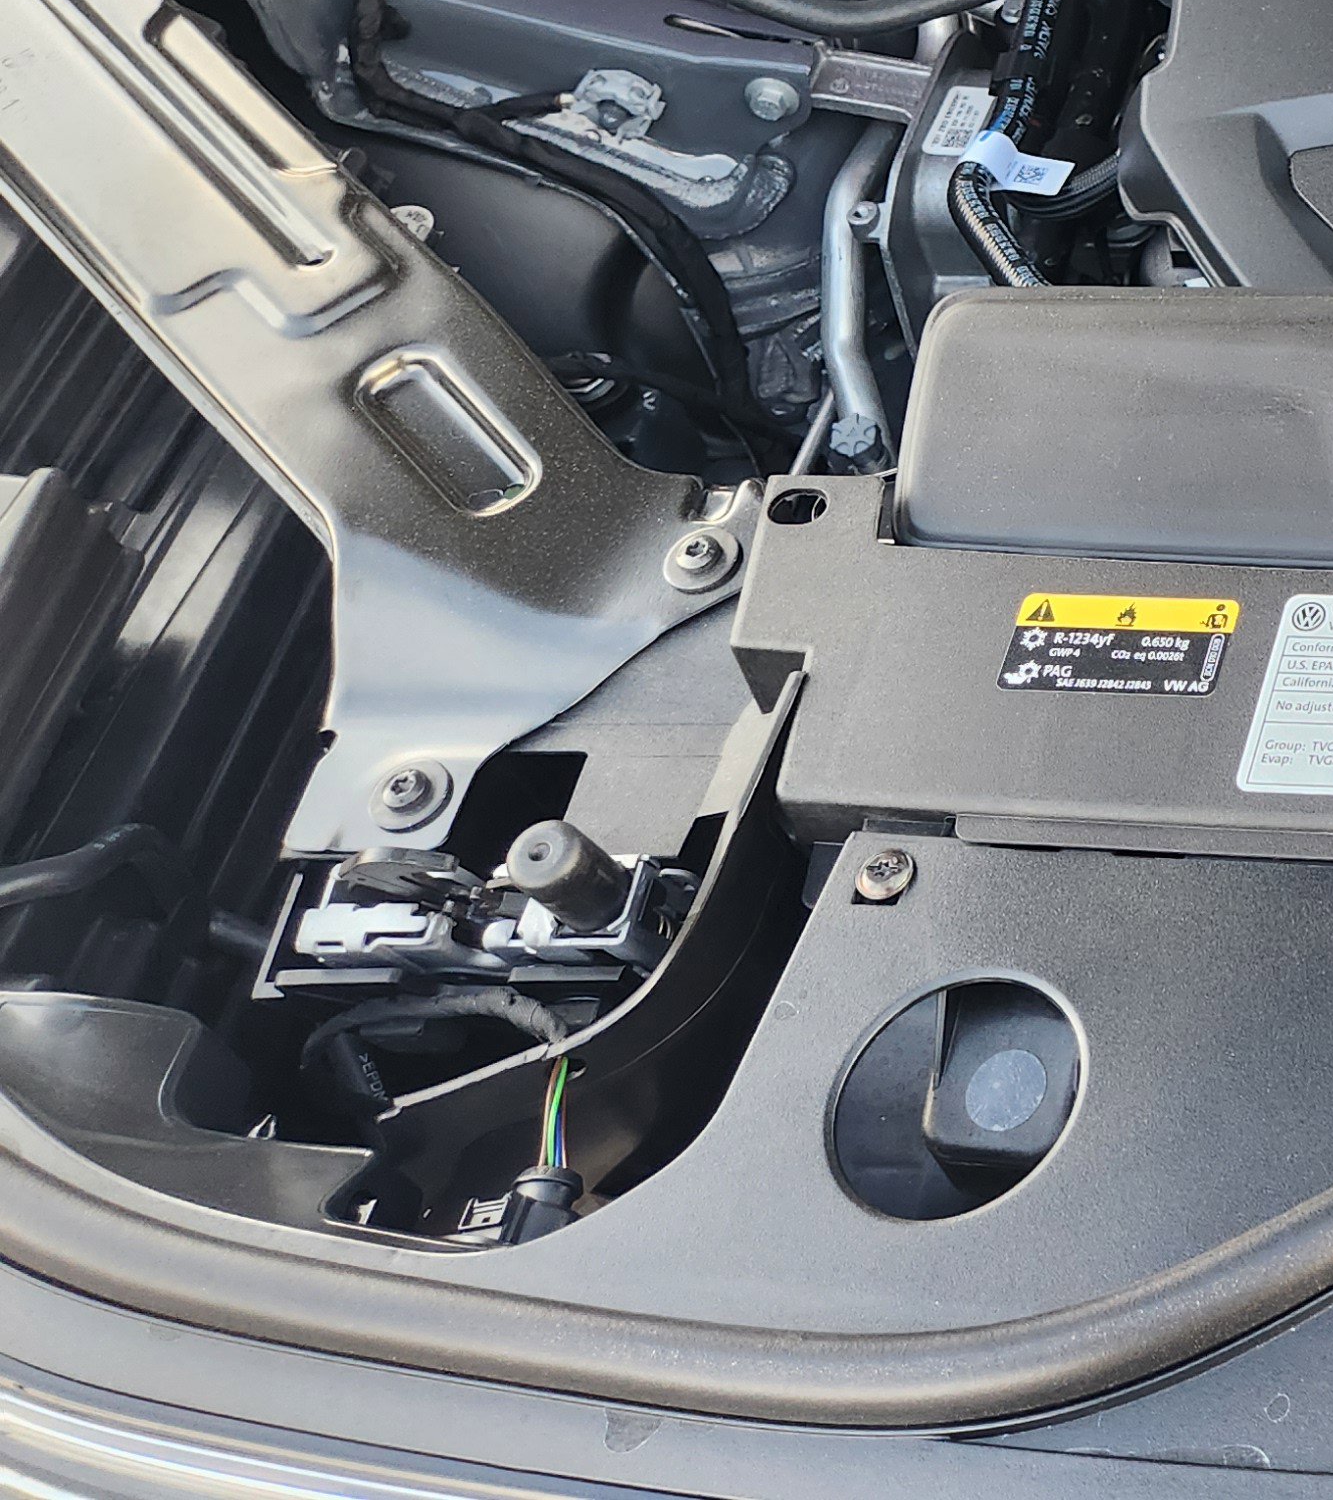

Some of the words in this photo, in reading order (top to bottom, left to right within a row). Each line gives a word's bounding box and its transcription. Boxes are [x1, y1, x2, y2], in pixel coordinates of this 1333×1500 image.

[1286, 659, 1308, 671] U.S.
[1274, 699, 1293, 711] No
[1263, 738, 1306, 754] Group:
[1259, 751, 1293, 767] Evap:
